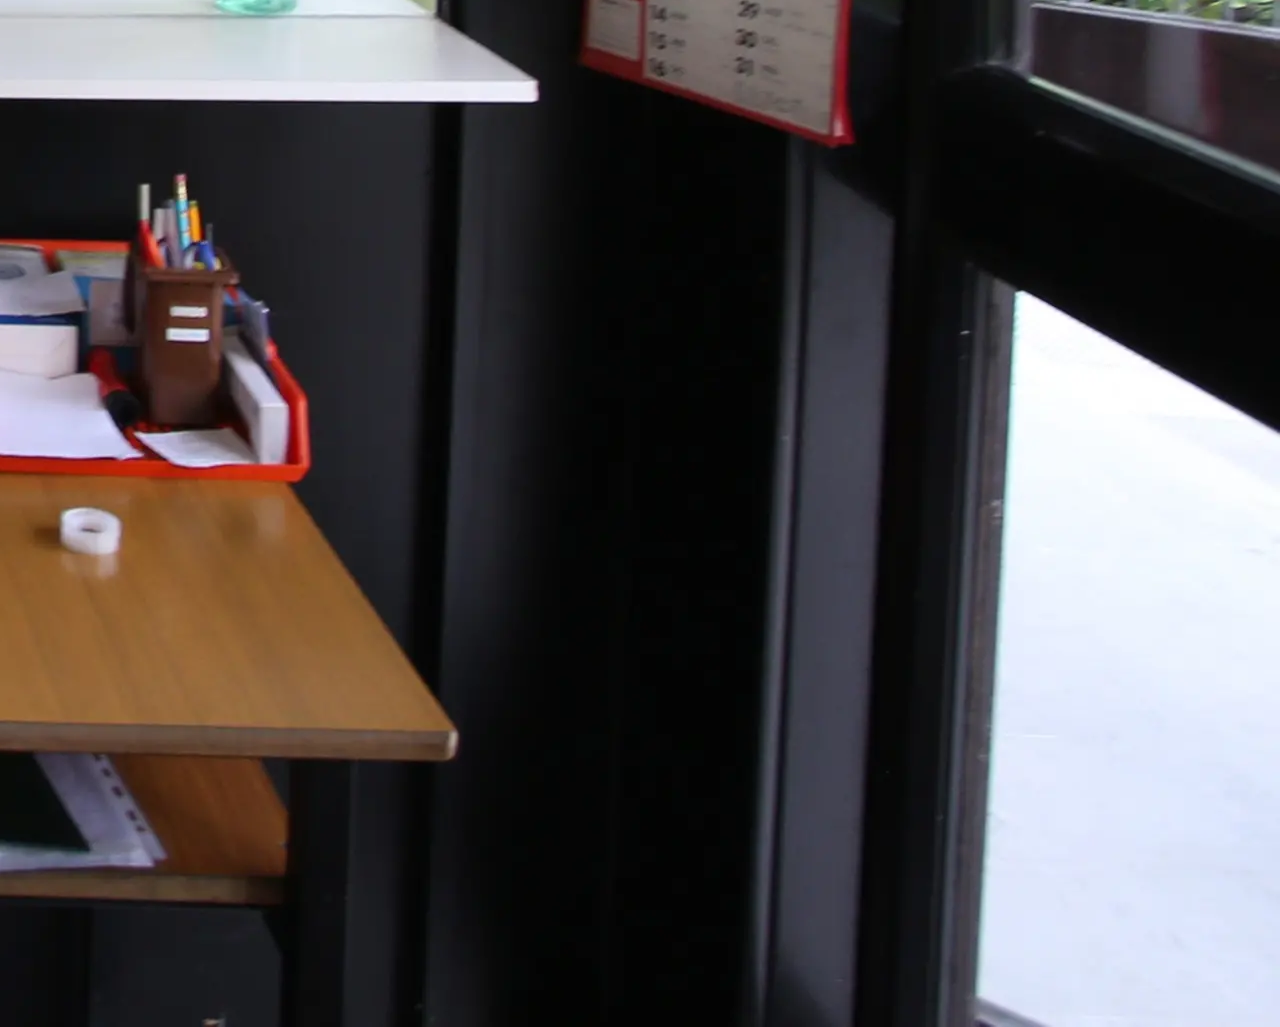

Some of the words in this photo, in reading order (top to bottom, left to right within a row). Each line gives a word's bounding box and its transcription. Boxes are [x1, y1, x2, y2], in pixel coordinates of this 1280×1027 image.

[648, 5, 668, 22] 14
[737, 0, 760, 19] 29
[648, 31, 668, 50] 15
[735, 56, 754, 77] 31
